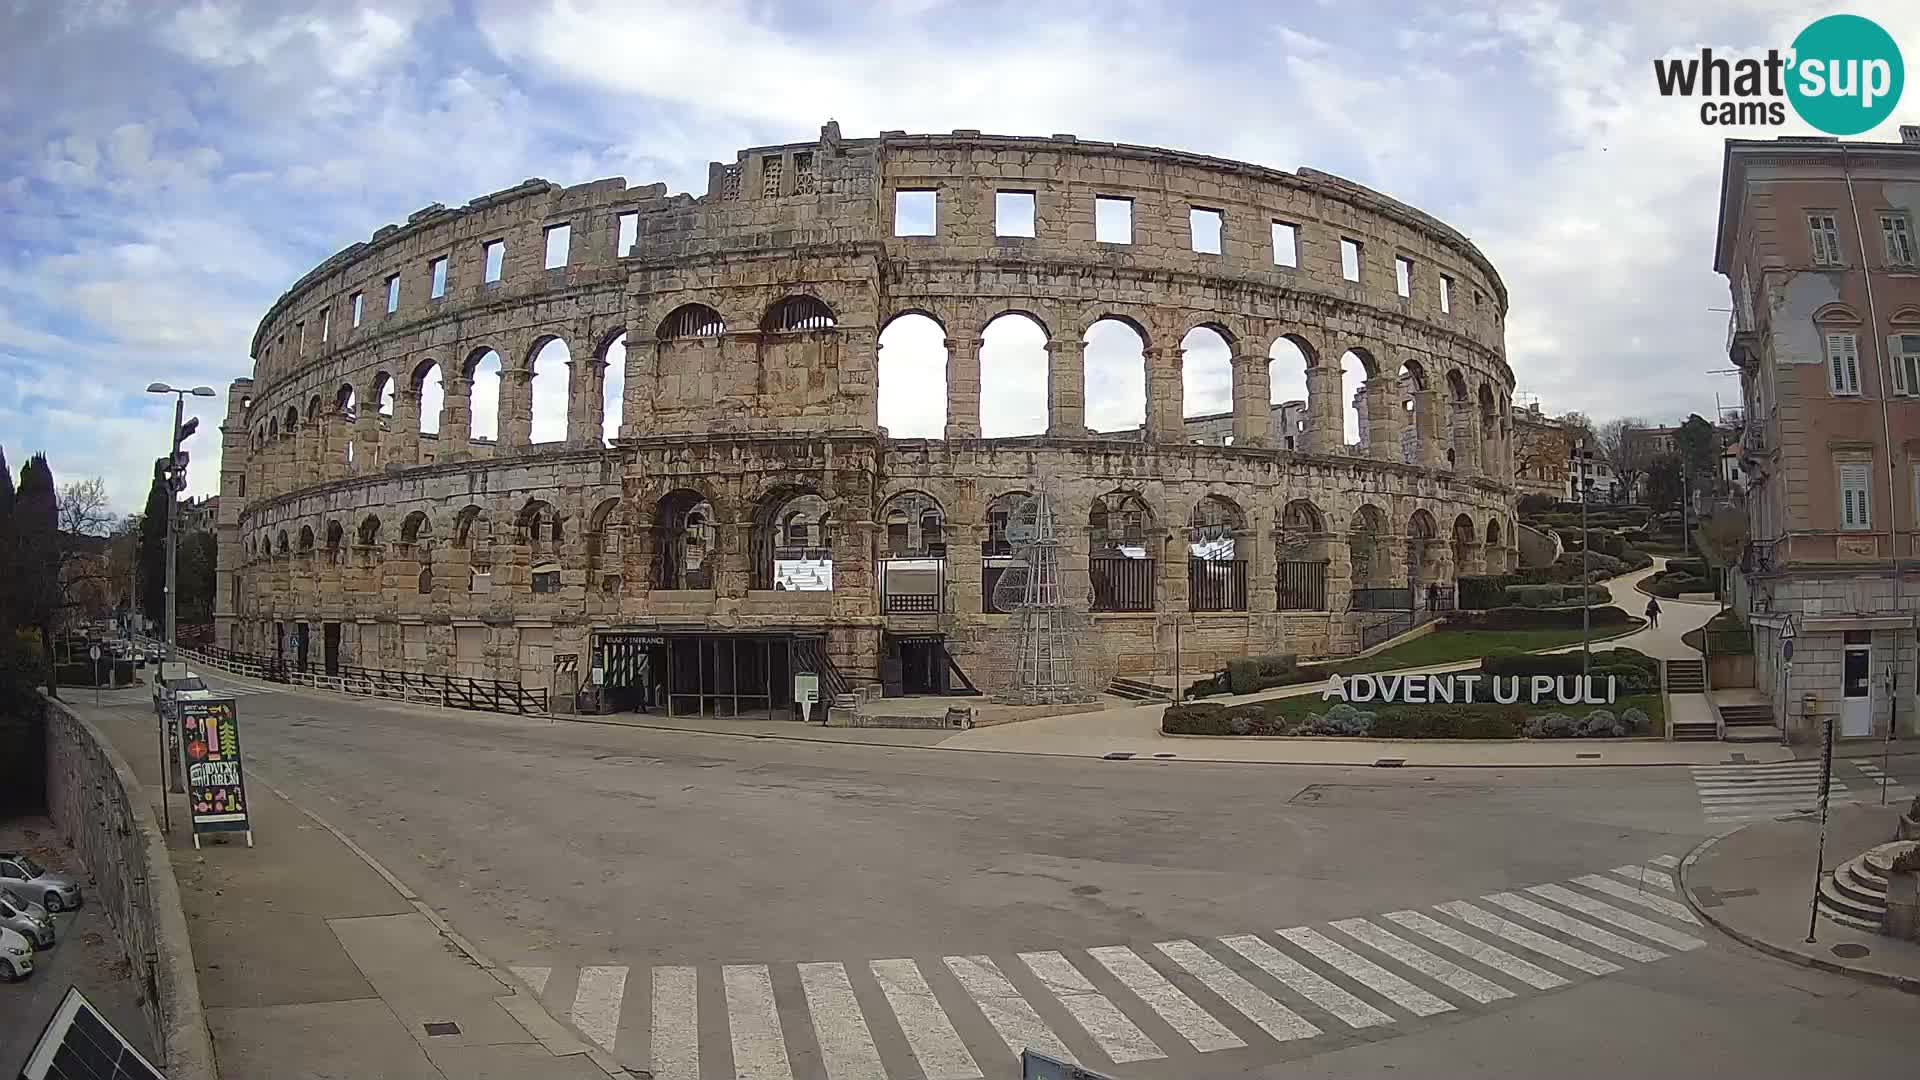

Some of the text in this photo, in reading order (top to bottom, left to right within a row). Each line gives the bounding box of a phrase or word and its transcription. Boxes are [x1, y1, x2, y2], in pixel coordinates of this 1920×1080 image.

[1322, 672, 1616, 704] ADVENT U PULI
